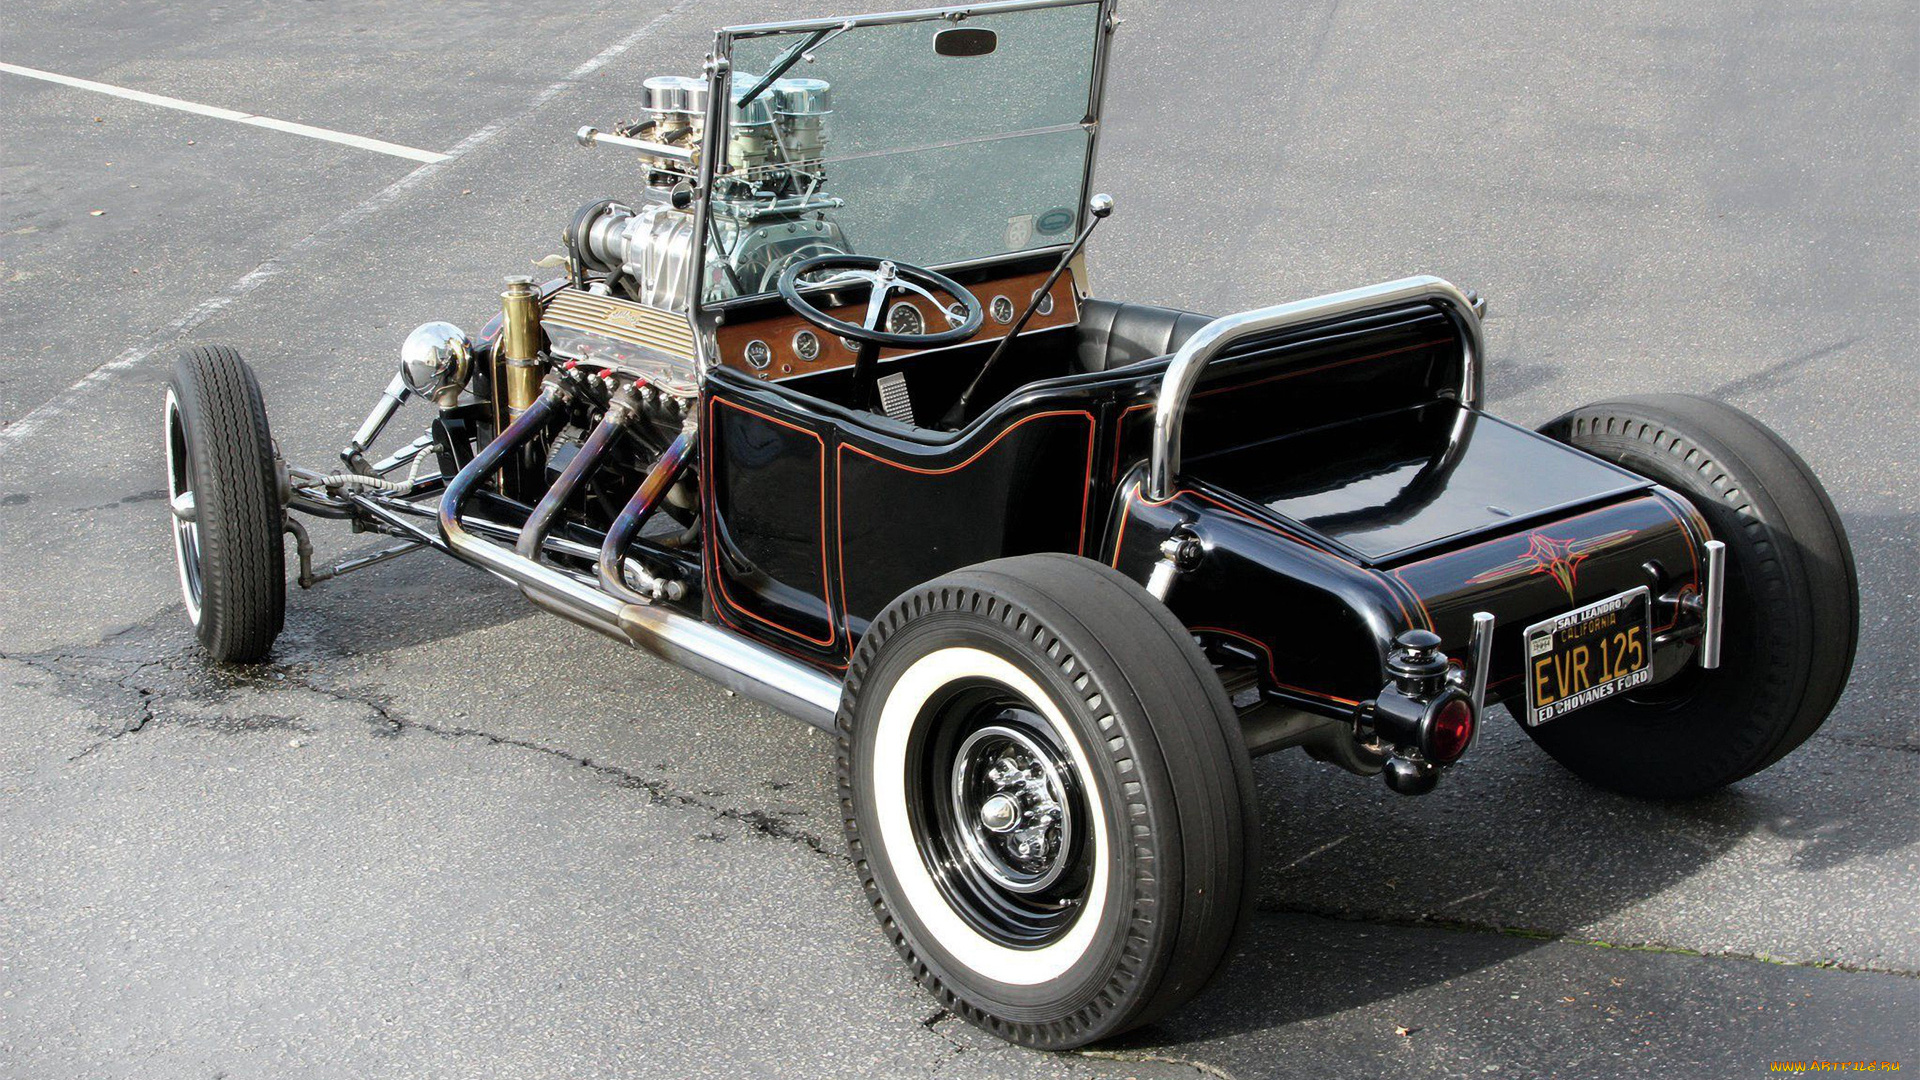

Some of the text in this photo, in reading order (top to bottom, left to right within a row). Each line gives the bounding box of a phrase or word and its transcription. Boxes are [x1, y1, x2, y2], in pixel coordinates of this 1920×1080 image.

[1557, 599, 1622, 629] SAN LEANDRO
[1561, 613, 1617, 643] CALIFORNIA
[1535, 626, 1643, 707] EVR 125
[1538, 670, 1648, 722] ED CHOVANES FORD
